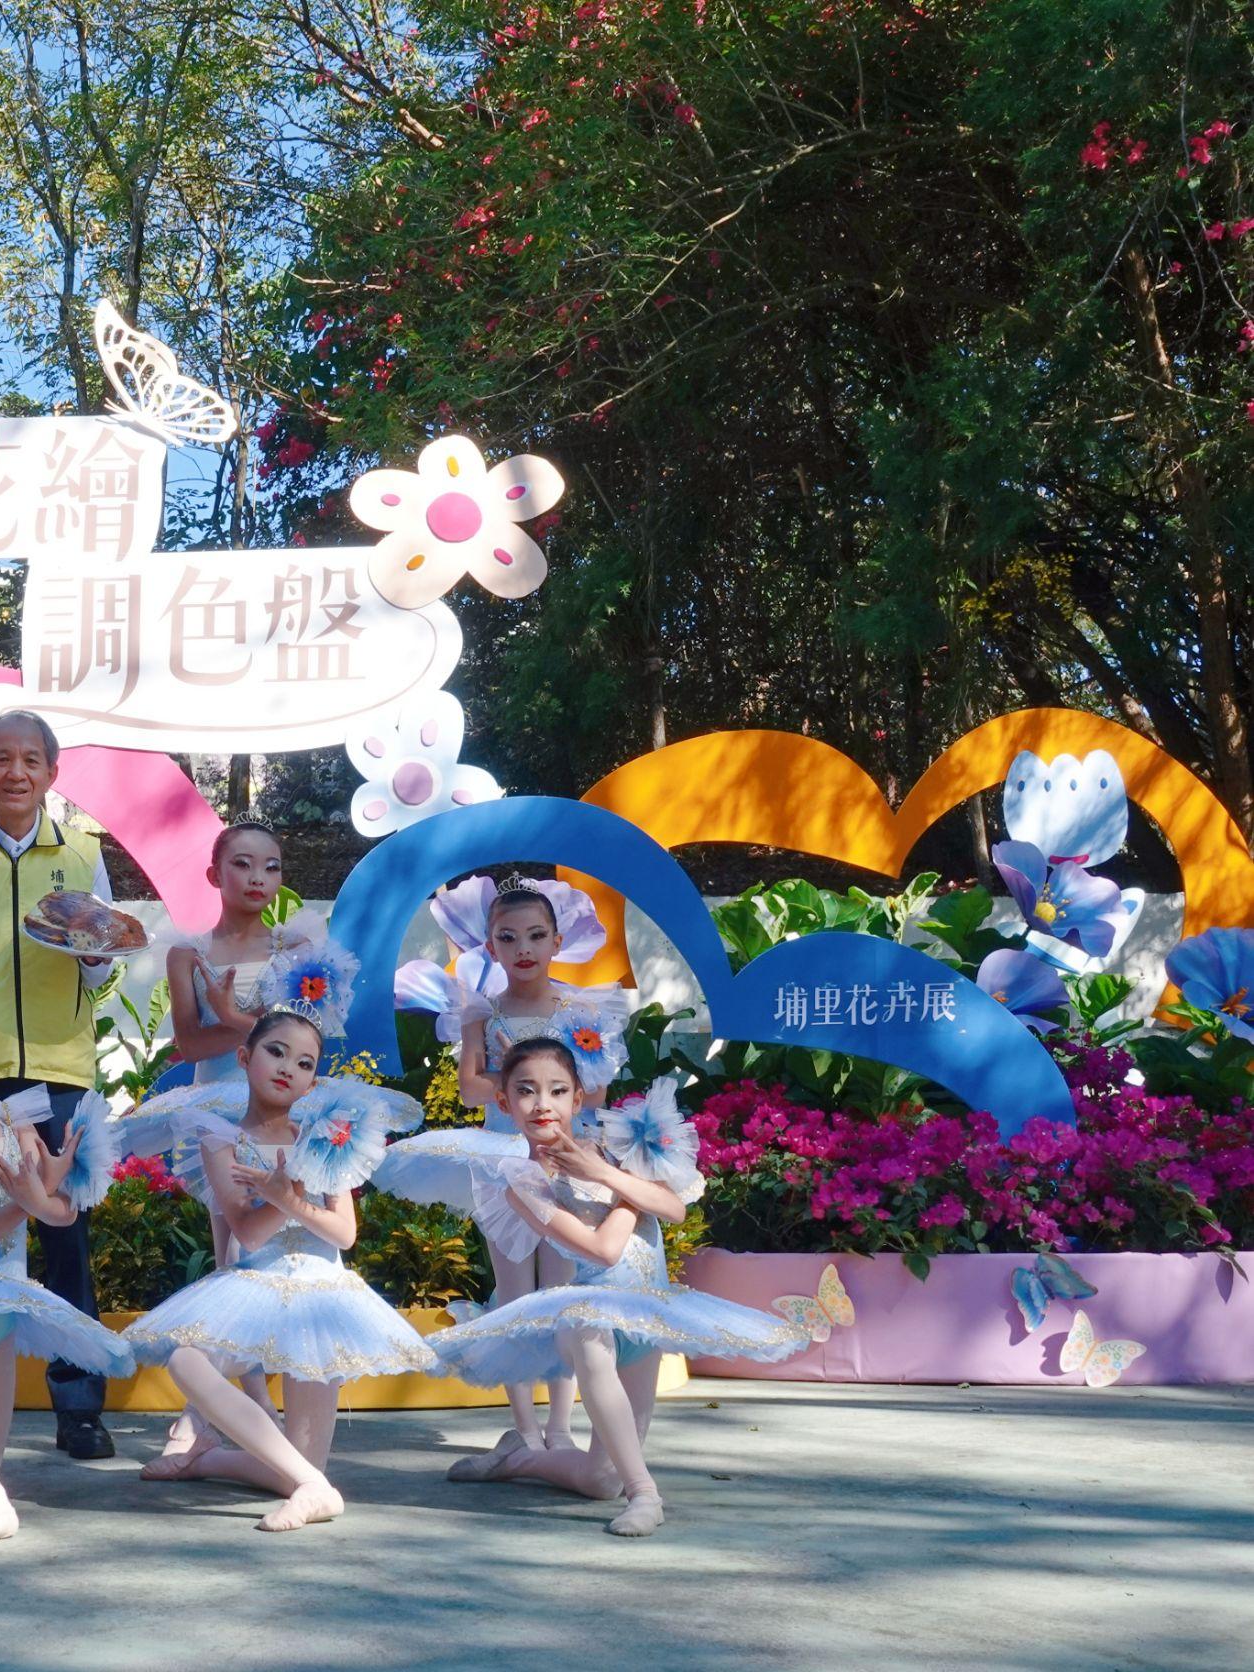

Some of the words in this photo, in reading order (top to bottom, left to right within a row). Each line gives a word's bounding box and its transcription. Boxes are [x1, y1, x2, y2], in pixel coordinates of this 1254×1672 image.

[37, 564, 368, 712] 調色盤
[773, 981, 957, 1032] 埔里花卉展
